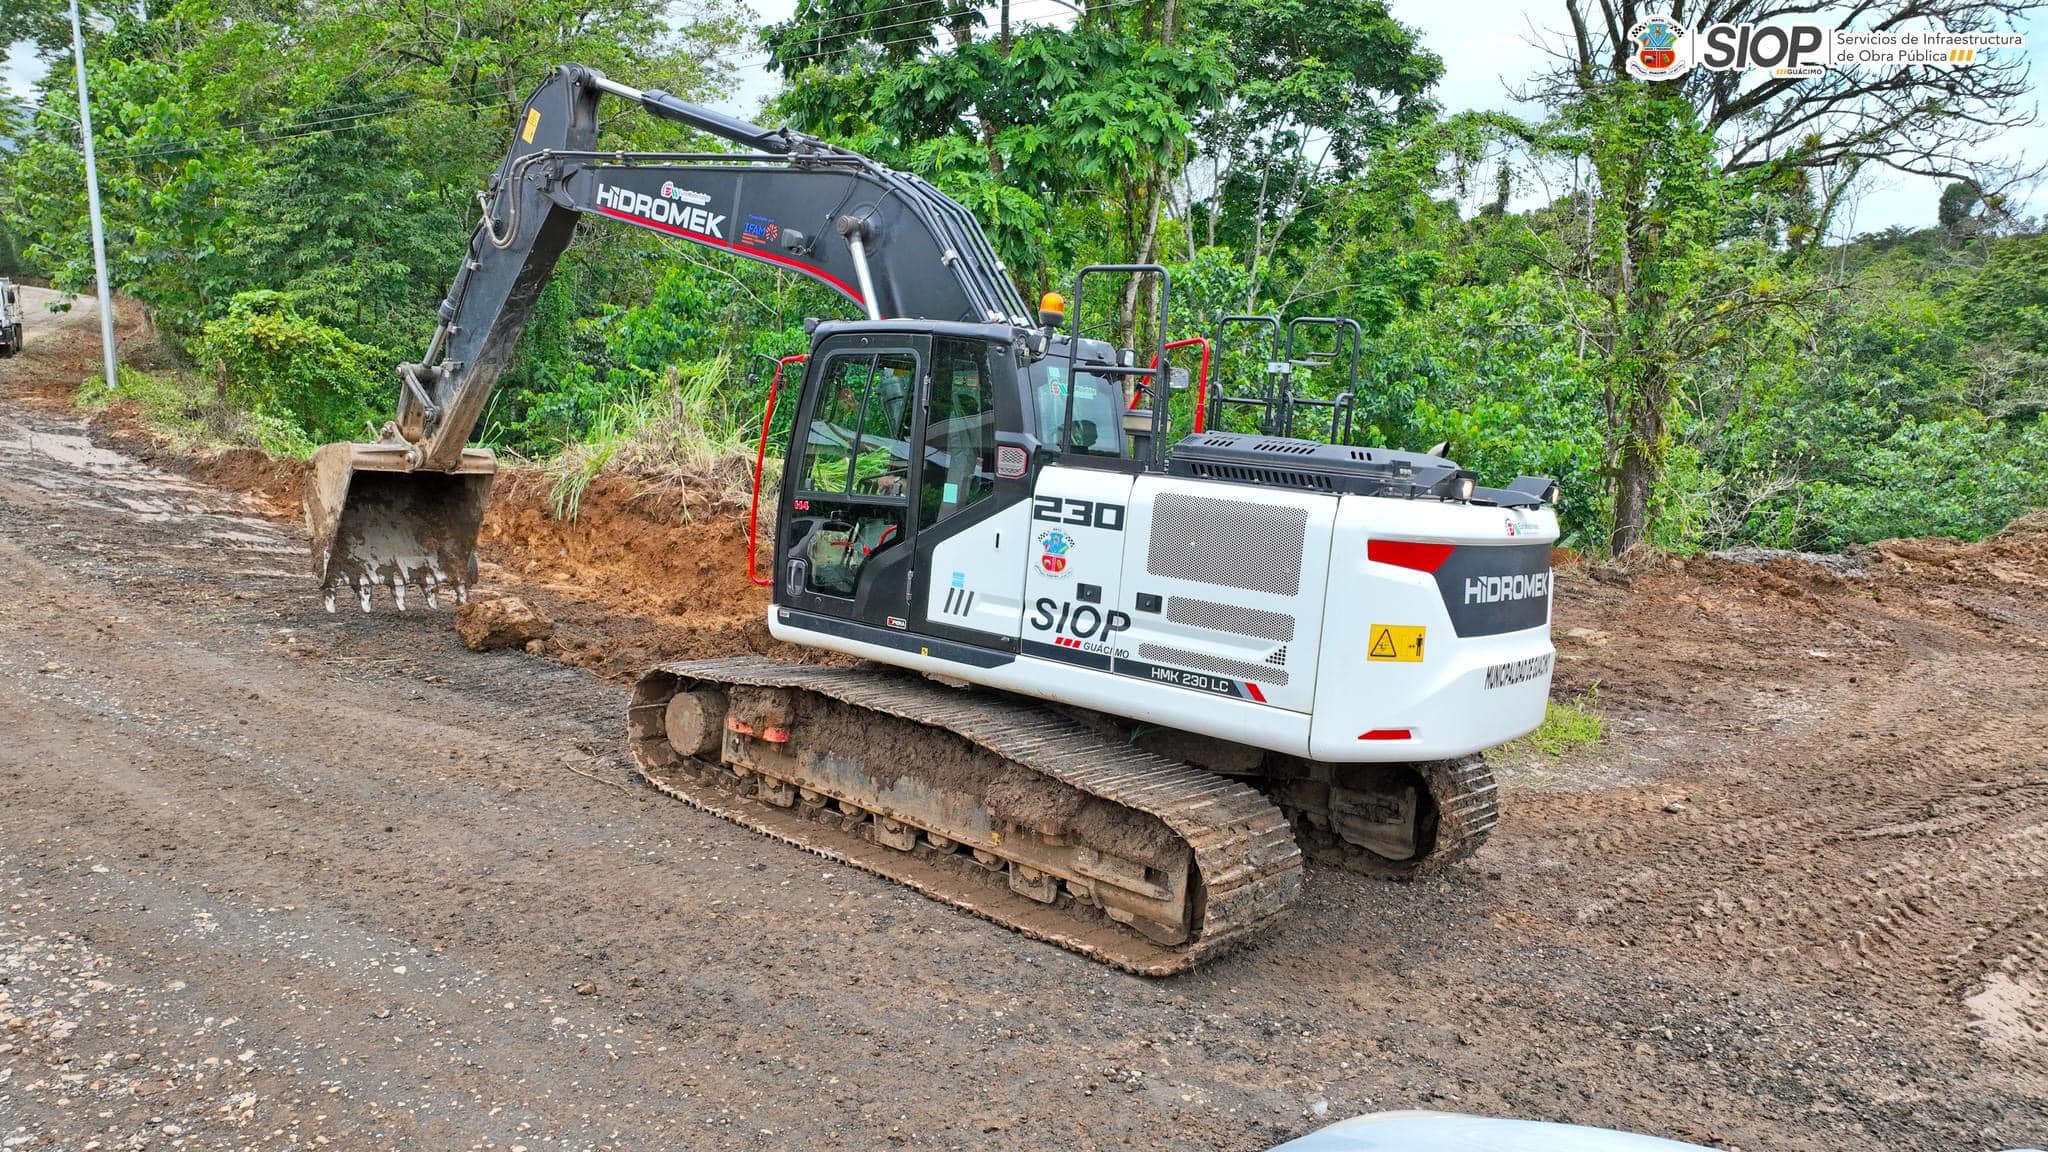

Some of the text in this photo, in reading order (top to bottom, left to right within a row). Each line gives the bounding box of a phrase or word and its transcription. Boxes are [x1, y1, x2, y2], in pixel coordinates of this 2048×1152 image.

[1033, 495, 1125, 531] 230
[1030, 597, 1132, 642] SIOP
[1151, 665, 1229, 693] HMK 230 LC
